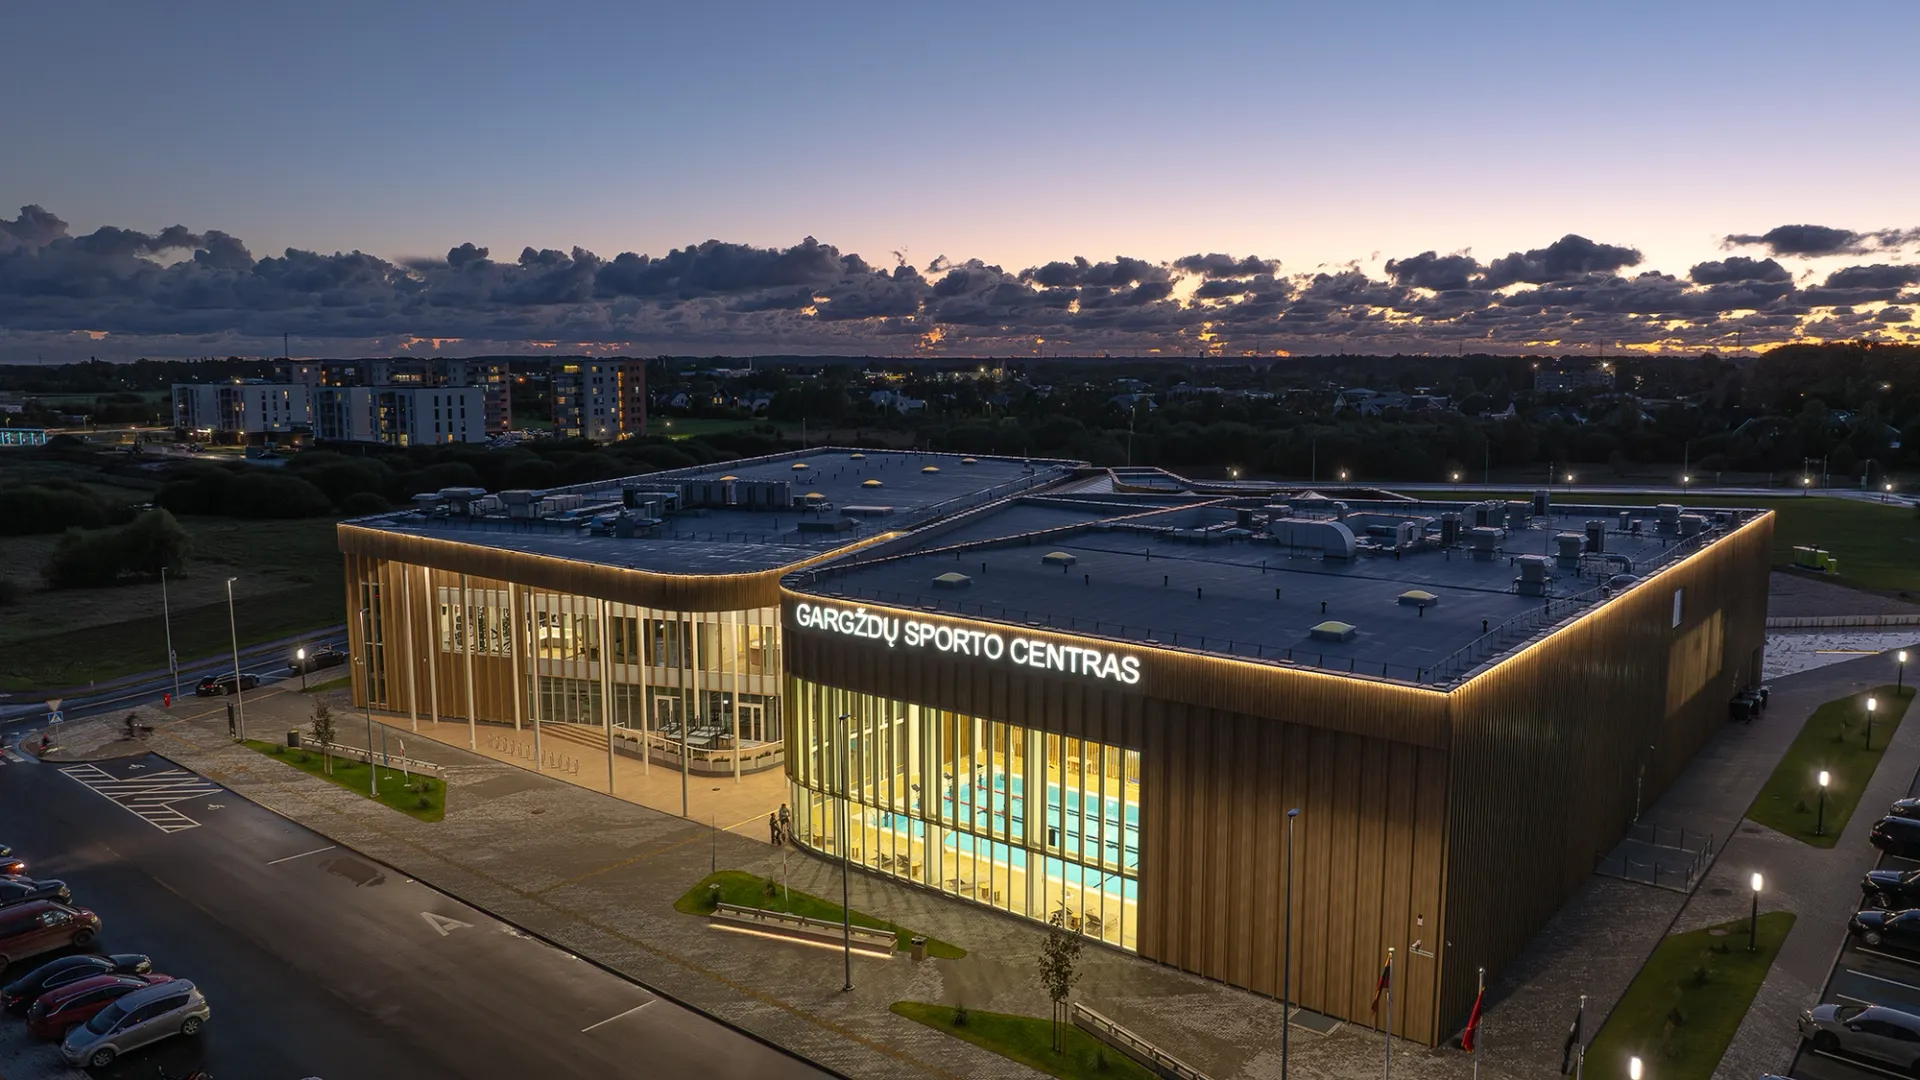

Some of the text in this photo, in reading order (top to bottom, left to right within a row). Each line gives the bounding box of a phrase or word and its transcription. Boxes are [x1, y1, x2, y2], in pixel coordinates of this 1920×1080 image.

[796, 602, 1141, 685] GARGŽDŲ SPORTO CENTRAS
[420, 911, 475, 937] A
